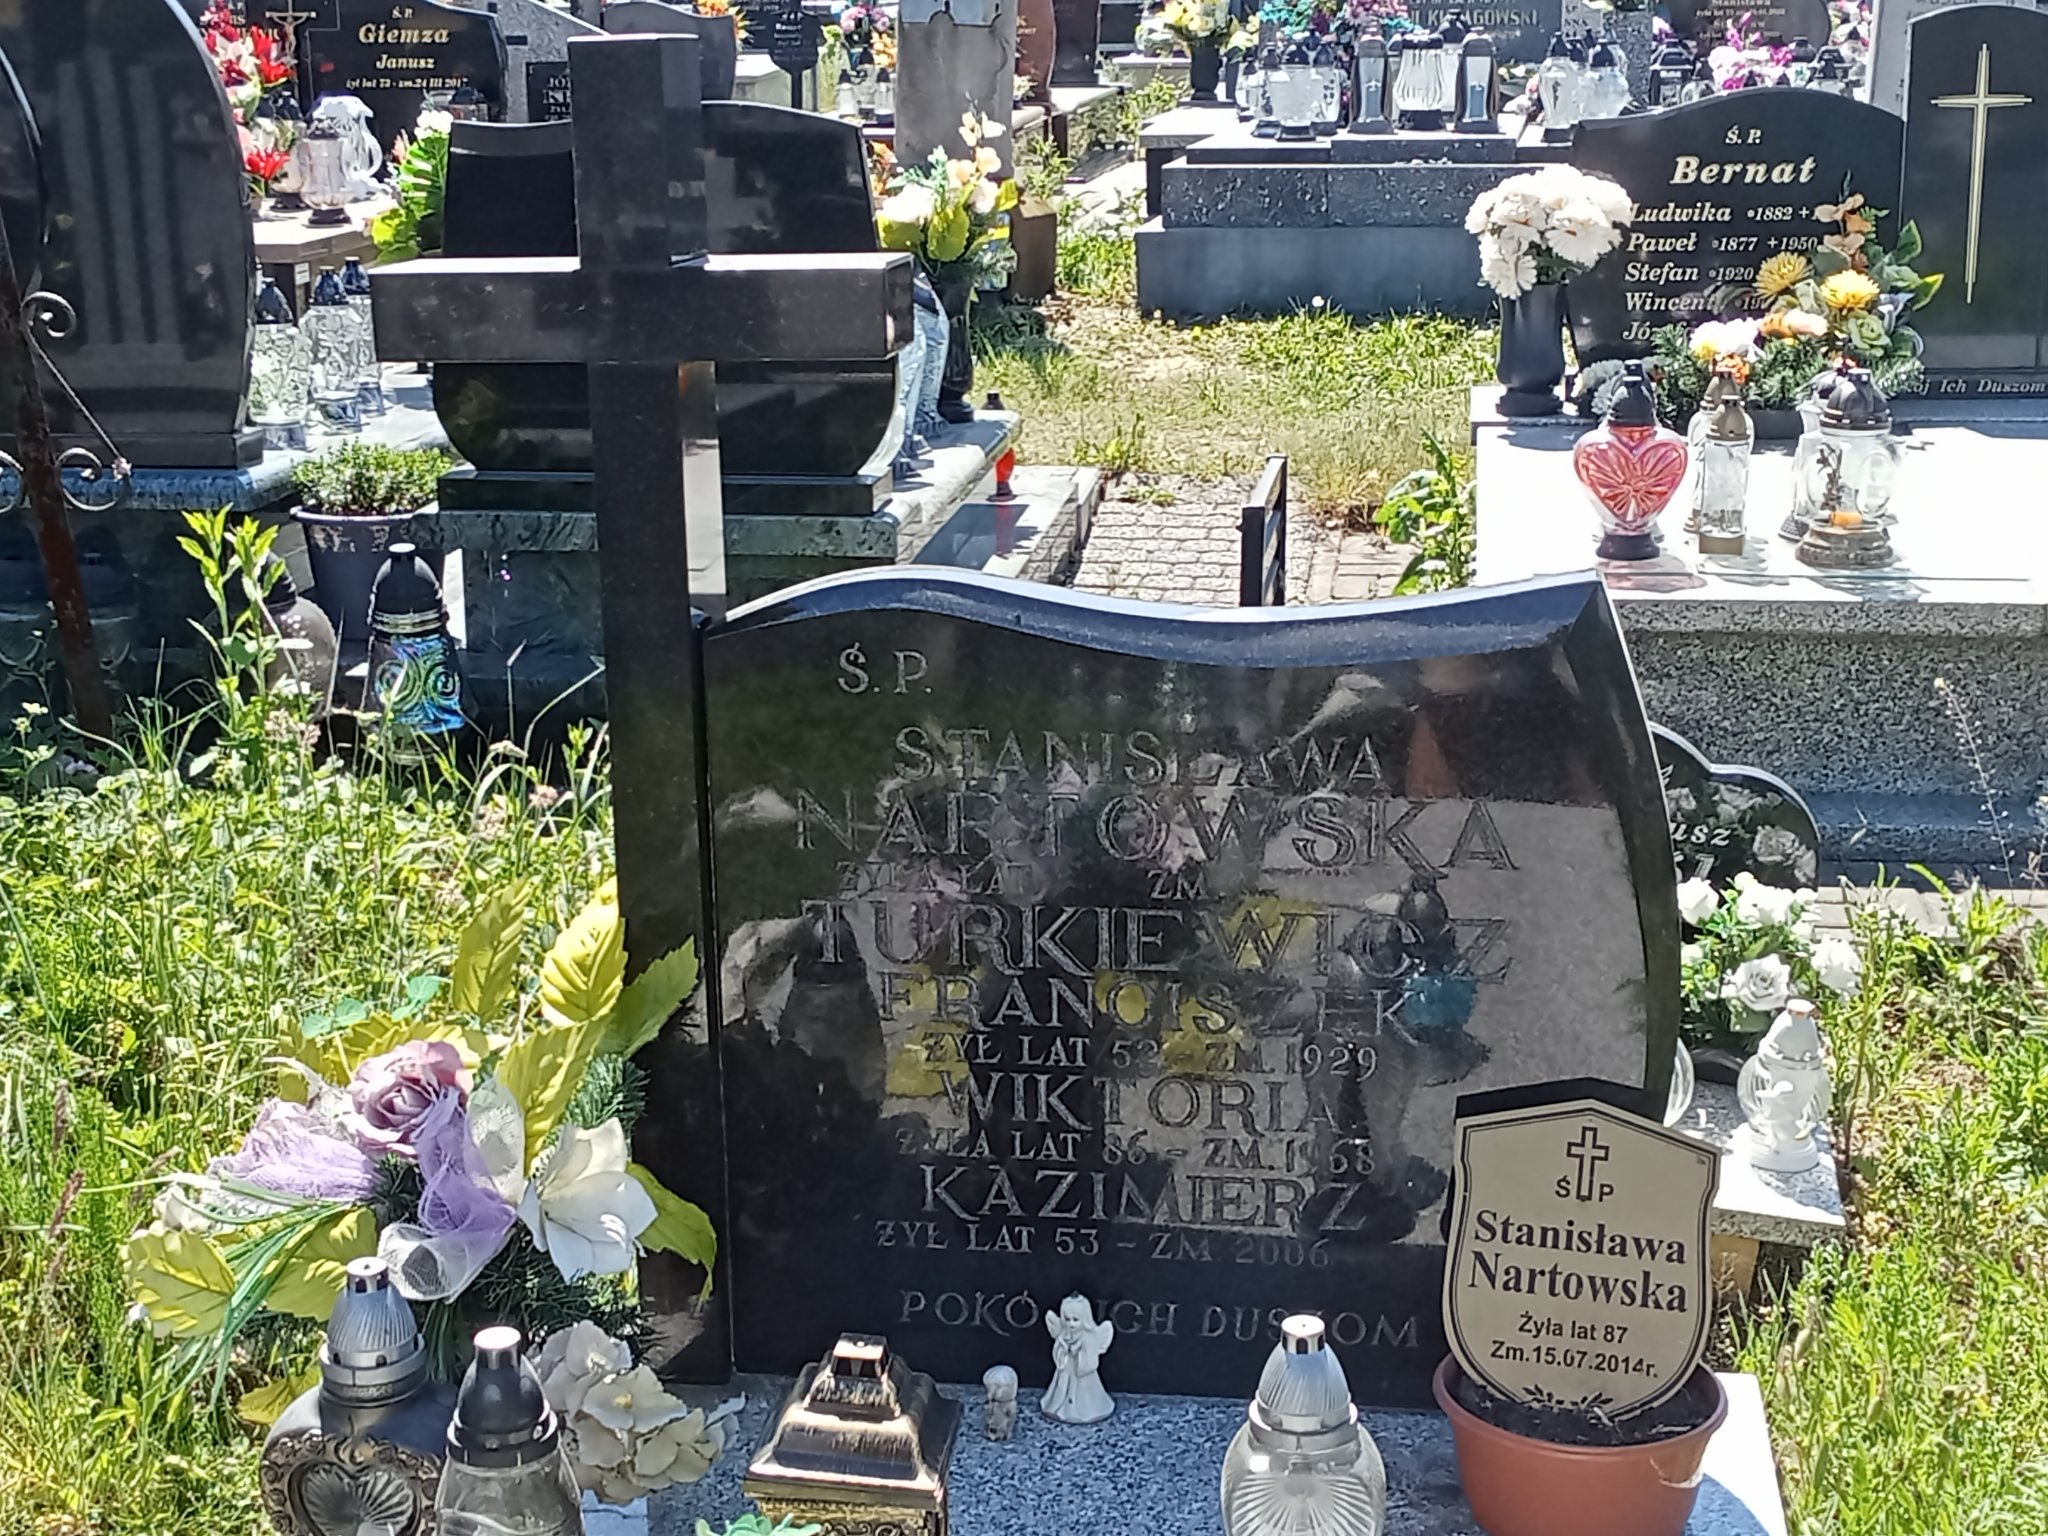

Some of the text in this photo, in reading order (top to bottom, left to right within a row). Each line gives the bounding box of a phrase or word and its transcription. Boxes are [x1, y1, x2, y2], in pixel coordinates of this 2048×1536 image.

[358, 23, 450, 44] Giemza
[375, 53, 436, 70] Janusz
[1669, 155, 1817, 184] Bernat
[1631, 202, 1732, 222] Ludwika
[1626, 232, 1698, 251] Paweł
[1625, 262, 1699, 285] Stefan
[1940, 379, 1967, 393] Ich
[1977, 378, 2046, 393] Duszom
[895, 726, 1390, 791] STANISŁAWA
[797, 787, 1518, 876] NARTOWSKA
[801, 900, 1513, 985] TURKIEWICZ
[878, 972, 1422, 1046] FRANCISZEK
[1018, 1034, 1091, 1067] LAT
[1286, 1042, 1378, 1082] 1929
[936, 1069, 1344, 1137] WIKTORIA
[1010, 1130, 1082, 1162] LAT
[919, 1163, 1367, 1236] KAZIMIERZ
[1599, 1183, 1614, 1202] P
[966, 1223, 1036, 1253] LAT
[1054, 1227, 1100, 1256] 53
[1475, 1209, 1686, 1264] Stanisława
[1468, 1250, 1687, 1313] Nartowska
[899, 1289, 1042, 1336] POKÓ
[1200, 1304, 1420, 1348] DUSOM
[1572, 1320, 1597, 1341] lat
[1603, 1324, 1628, 1344] 87
